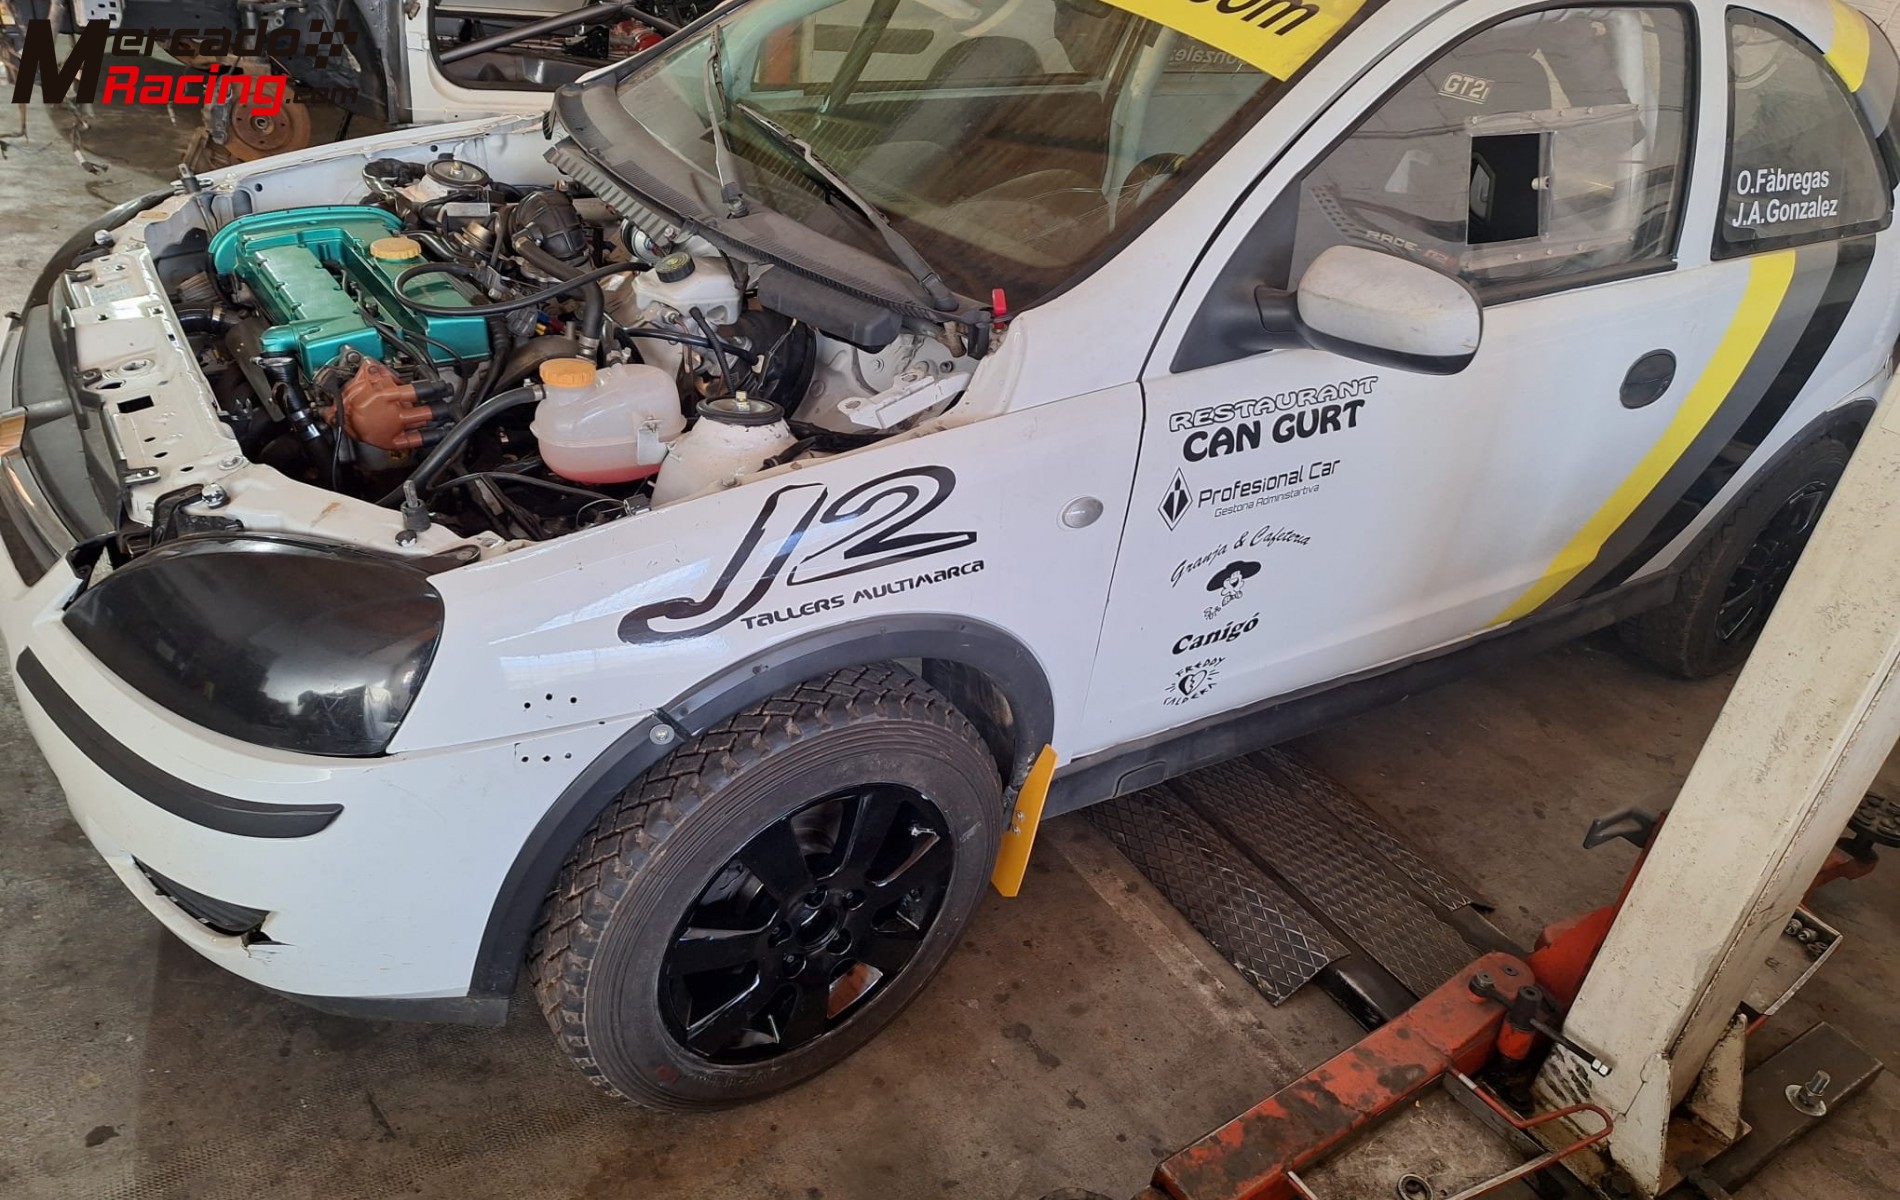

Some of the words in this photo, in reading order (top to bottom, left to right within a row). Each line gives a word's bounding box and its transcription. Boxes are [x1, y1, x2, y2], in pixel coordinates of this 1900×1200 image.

[1189, 0, 1320, 36] om
[1736, 168, 1830, 195] O.Fàbregas
[1732, 195, 1838, 227] J.A.Gonzalez
[1169, 376, 1378, 432] RESTAURANT
[1183, 420, 1261, 462] CAN
[1272, 399, 1365, 444] GURT
[1198, 465, 1303, 508] Profesional
[1309, 460, 1341, 480] Car
[617, 465, 978, 645] J2
[1171, 544, 1228, 588] Granja
[1233, 531, 1249, 549] &
[741, 595, 845, 630] TALLERS
[1172, 612, 1260, 655] Canigó
